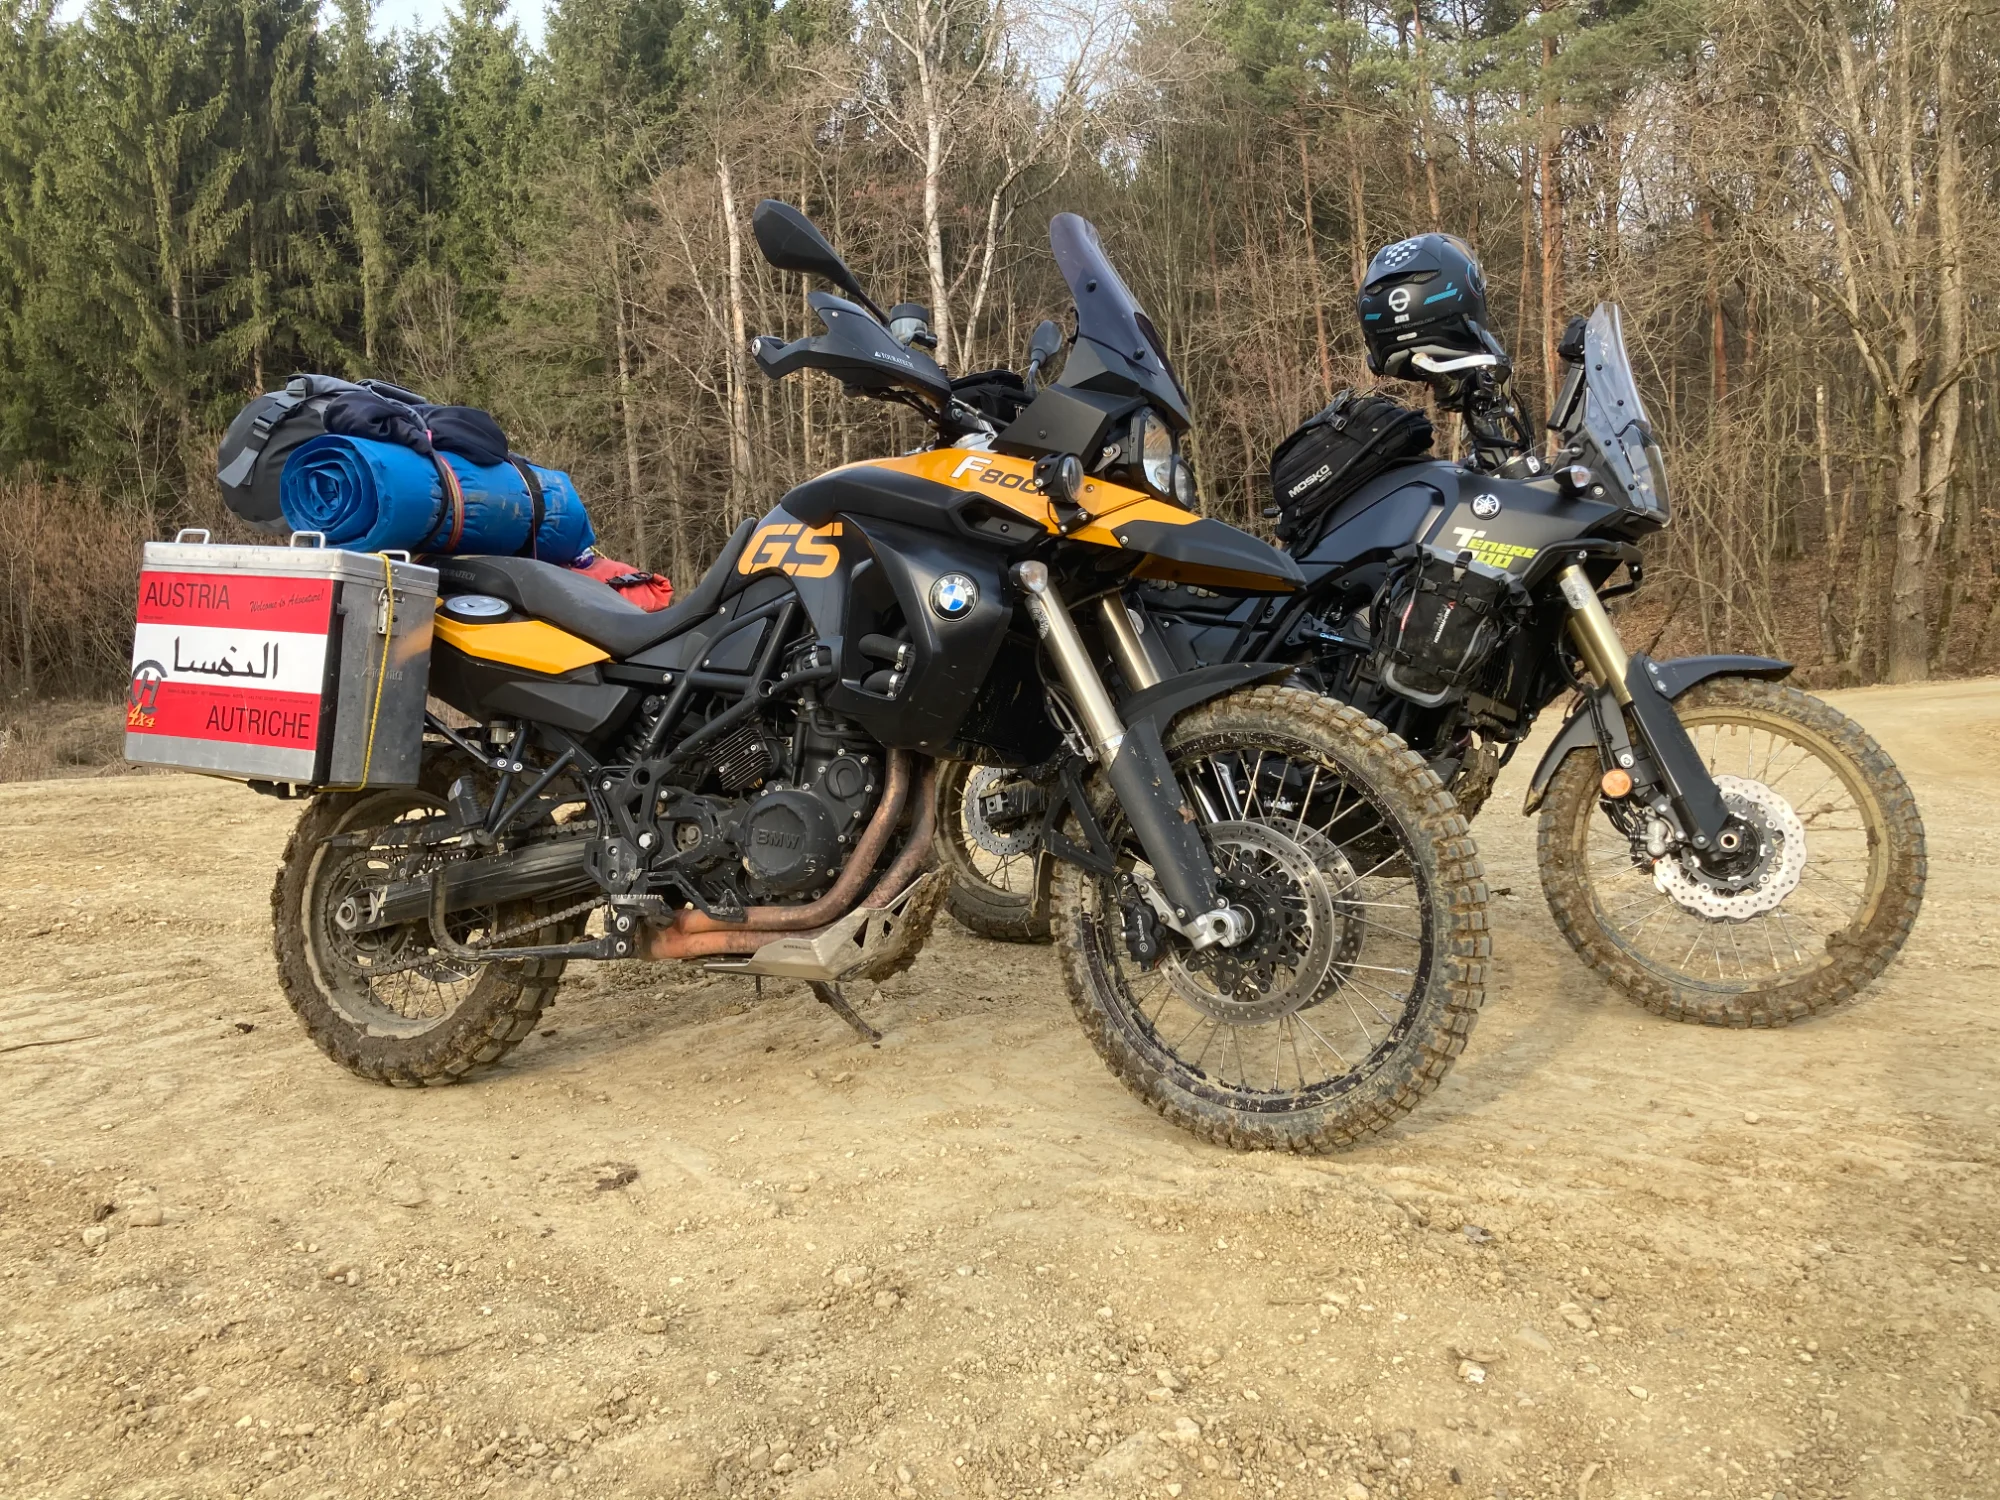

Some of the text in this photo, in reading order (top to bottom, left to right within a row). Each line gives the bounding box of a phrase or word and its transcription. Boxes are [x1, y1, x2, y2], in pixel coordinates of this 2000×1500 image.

[1288, 464, 1330, 498] MOSKO
[738, 522, 843, 578] GS
[145, 582, 230, 610] AUSTRIA
[250, 601, 277, 613] Welcome
[174, 636, 279, 680] النمسا
[206, 705, 311, 740] AUTRICHE
[757, 828, 801, 850] BMW
